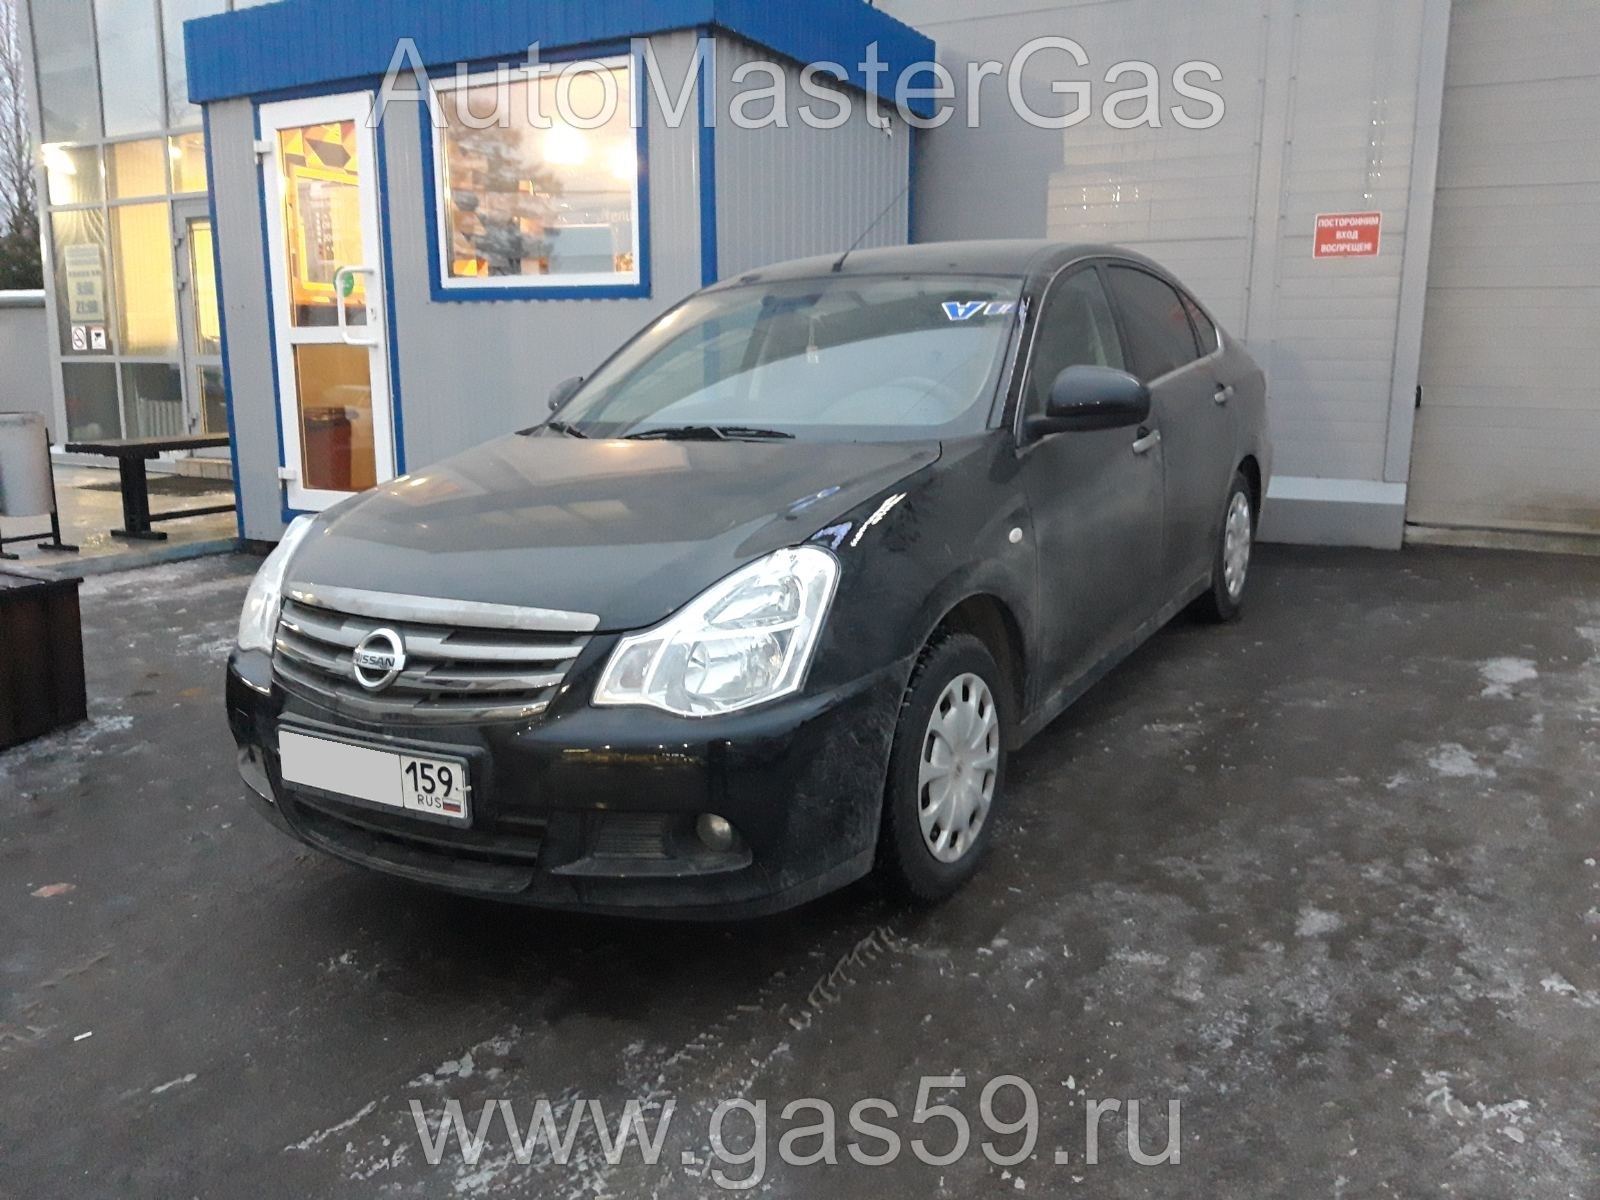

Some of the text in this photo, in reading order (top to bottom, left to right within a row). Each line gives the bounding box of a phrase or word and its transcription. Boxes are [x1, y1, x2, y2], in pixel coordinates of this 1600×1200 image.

[1336, 230, 1358, 240] ВХОД
[405, 761, 453, 797] 159
[417, 793, 442, 808] RUS
